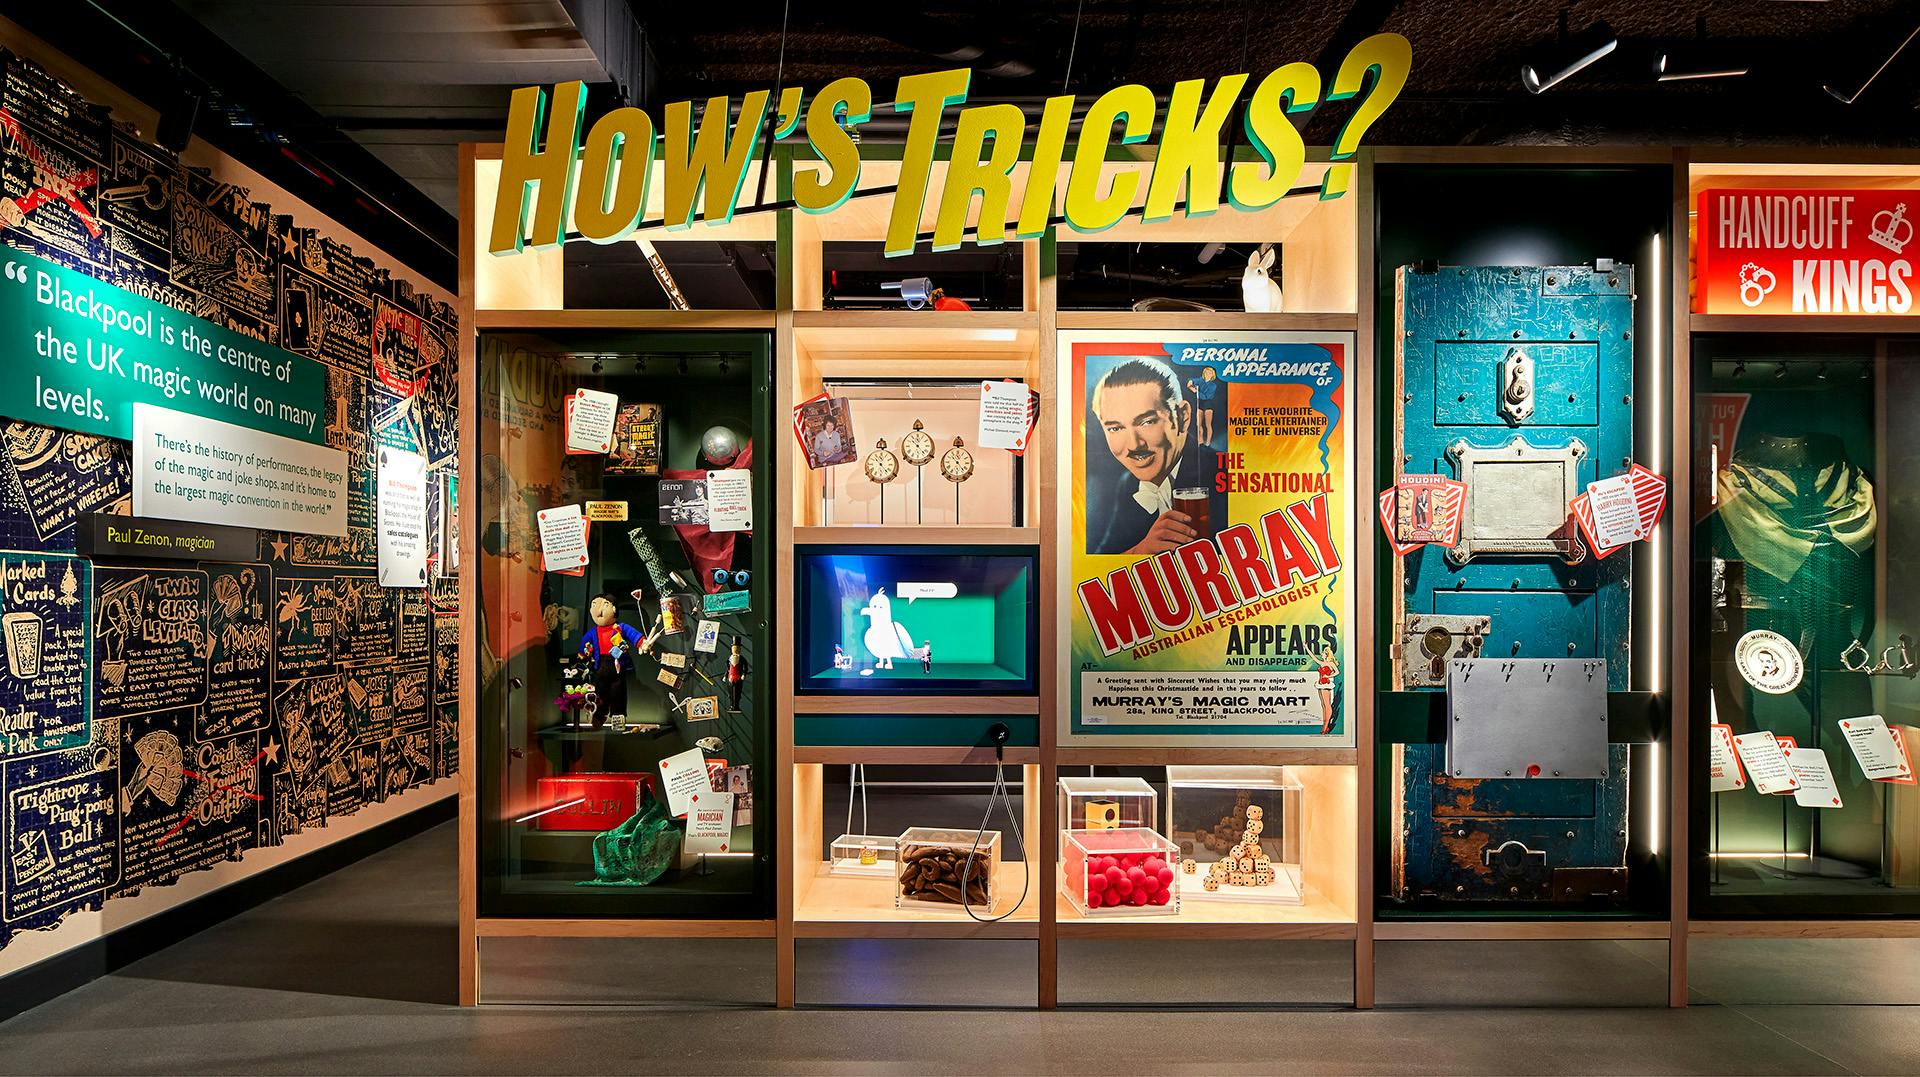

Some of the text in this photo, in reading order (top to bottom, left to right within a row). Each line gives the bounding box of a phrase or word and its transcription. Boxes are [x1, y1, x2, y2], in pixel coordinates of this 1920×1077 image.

[488, 31, 1414, 258] HOW'S TRICKS?
[2, 167, 27, 188] LOOKS
[33, 165, 76, 202] INK
[1719, 195, 1855, 250] HANDCUFF
[1792, 258, 1913, 314] KINGS
[160, 317, 174, 345] is
[181, 325, 212, 358] the
[218, 341, 270, 377] centre
[276, 360, 292, 384] of
[1181, 348, 1268, 362] PERSONAL
[34, 325, 317, 434] the UK magic world on many
[1222, 362, 1331, 377] APPEARANCE
[1316, 377, 1334, 386] OF
[35, 375, 110, 422] levels.
[1229, 416, 1328, 426] MAGICAL ENTERTAINER
[1243, 407, 1313, 416] THE FAVOURITE
[1235, 427, 1321, 436] OF THE UNIVERSE
[194, 443, 210, 457] the
[213, 446, 243, 467] history
[245, 453, 255, 465] of
[256, 456, 310, 477] performances,
[310, 466, 322, 479] the
[323, 468, 343, 485] legacy
[1215, 452, 1245, 470] THE
[155, 458, 166, 471] of
[169, 461, 185, 474] the
[188, 466, 214, 482] magic
[217, 469, 233, 483] and
[234, 471, 253, 487] joke
[255, 476, 279, 492] shops,
[281, 479, 294, 493] and
[308, 483, 327, 498] home
[328, 488, 336, 499] to
[1215, 472, 1335, 493] SENSATIONAL
[40, 477, 120, 532] WHAT A WHEEZE!
[154, 480, 171, 495] the
[175, 482, 206, 501] largest
[209, 489, 234, 506] magic
[236, 494, 281, 510] convention
[282, 499, 290, 511] in
[291, 499, 304, 512] the
[107, 526, 215, 552] Paul Zenon, magician
[1077, 493, 1342, 657] MURRAY
[13, 582, 56, 604] Cards
[155, 576, 200, 597] TWIN
[158, 599, 199, 621] GLASS
[55, 623, 60, 638] A
[1132, 582, 1320, 661] AUSTRALIAN ESCAPOLOGIST
[1226, 624, 1337, 656] APPEARS
[70, 650, 78, 659] to
[214, 655, 234, 674] card
[1226, 658, 1307, 666] AND DISAPPEARS
[64, 664, 79, 676] you
[80, 659, 87, 669] to
[32, 672, 82, 687] read the card
[49, 687, 67, 700] from
[1092, 696, 1310, 706] MURRAY'S MAGIC MART
[43, 716, 62, 727] FOR
[43, 722, 86, 737] AMUSEMENT
[7, 732, 40, 755] Pack
[43, 737, 64, 747] ONLY
[198, 738, 237, 769] Card
[207, 765, 256, 792] Fanning
[18, 782, 89, 815] Tightrope
[200, 788, 245, 826] Outfit
[59, 822, 92, 850] Ball
[15, 845, 37, 866] EASY
[23, 859, 35, 868] TO
[18, 857, 49, 880] PERFORM
[14, 900, 38, 912] NYLON
[41, 891, 60, 902] CORD
